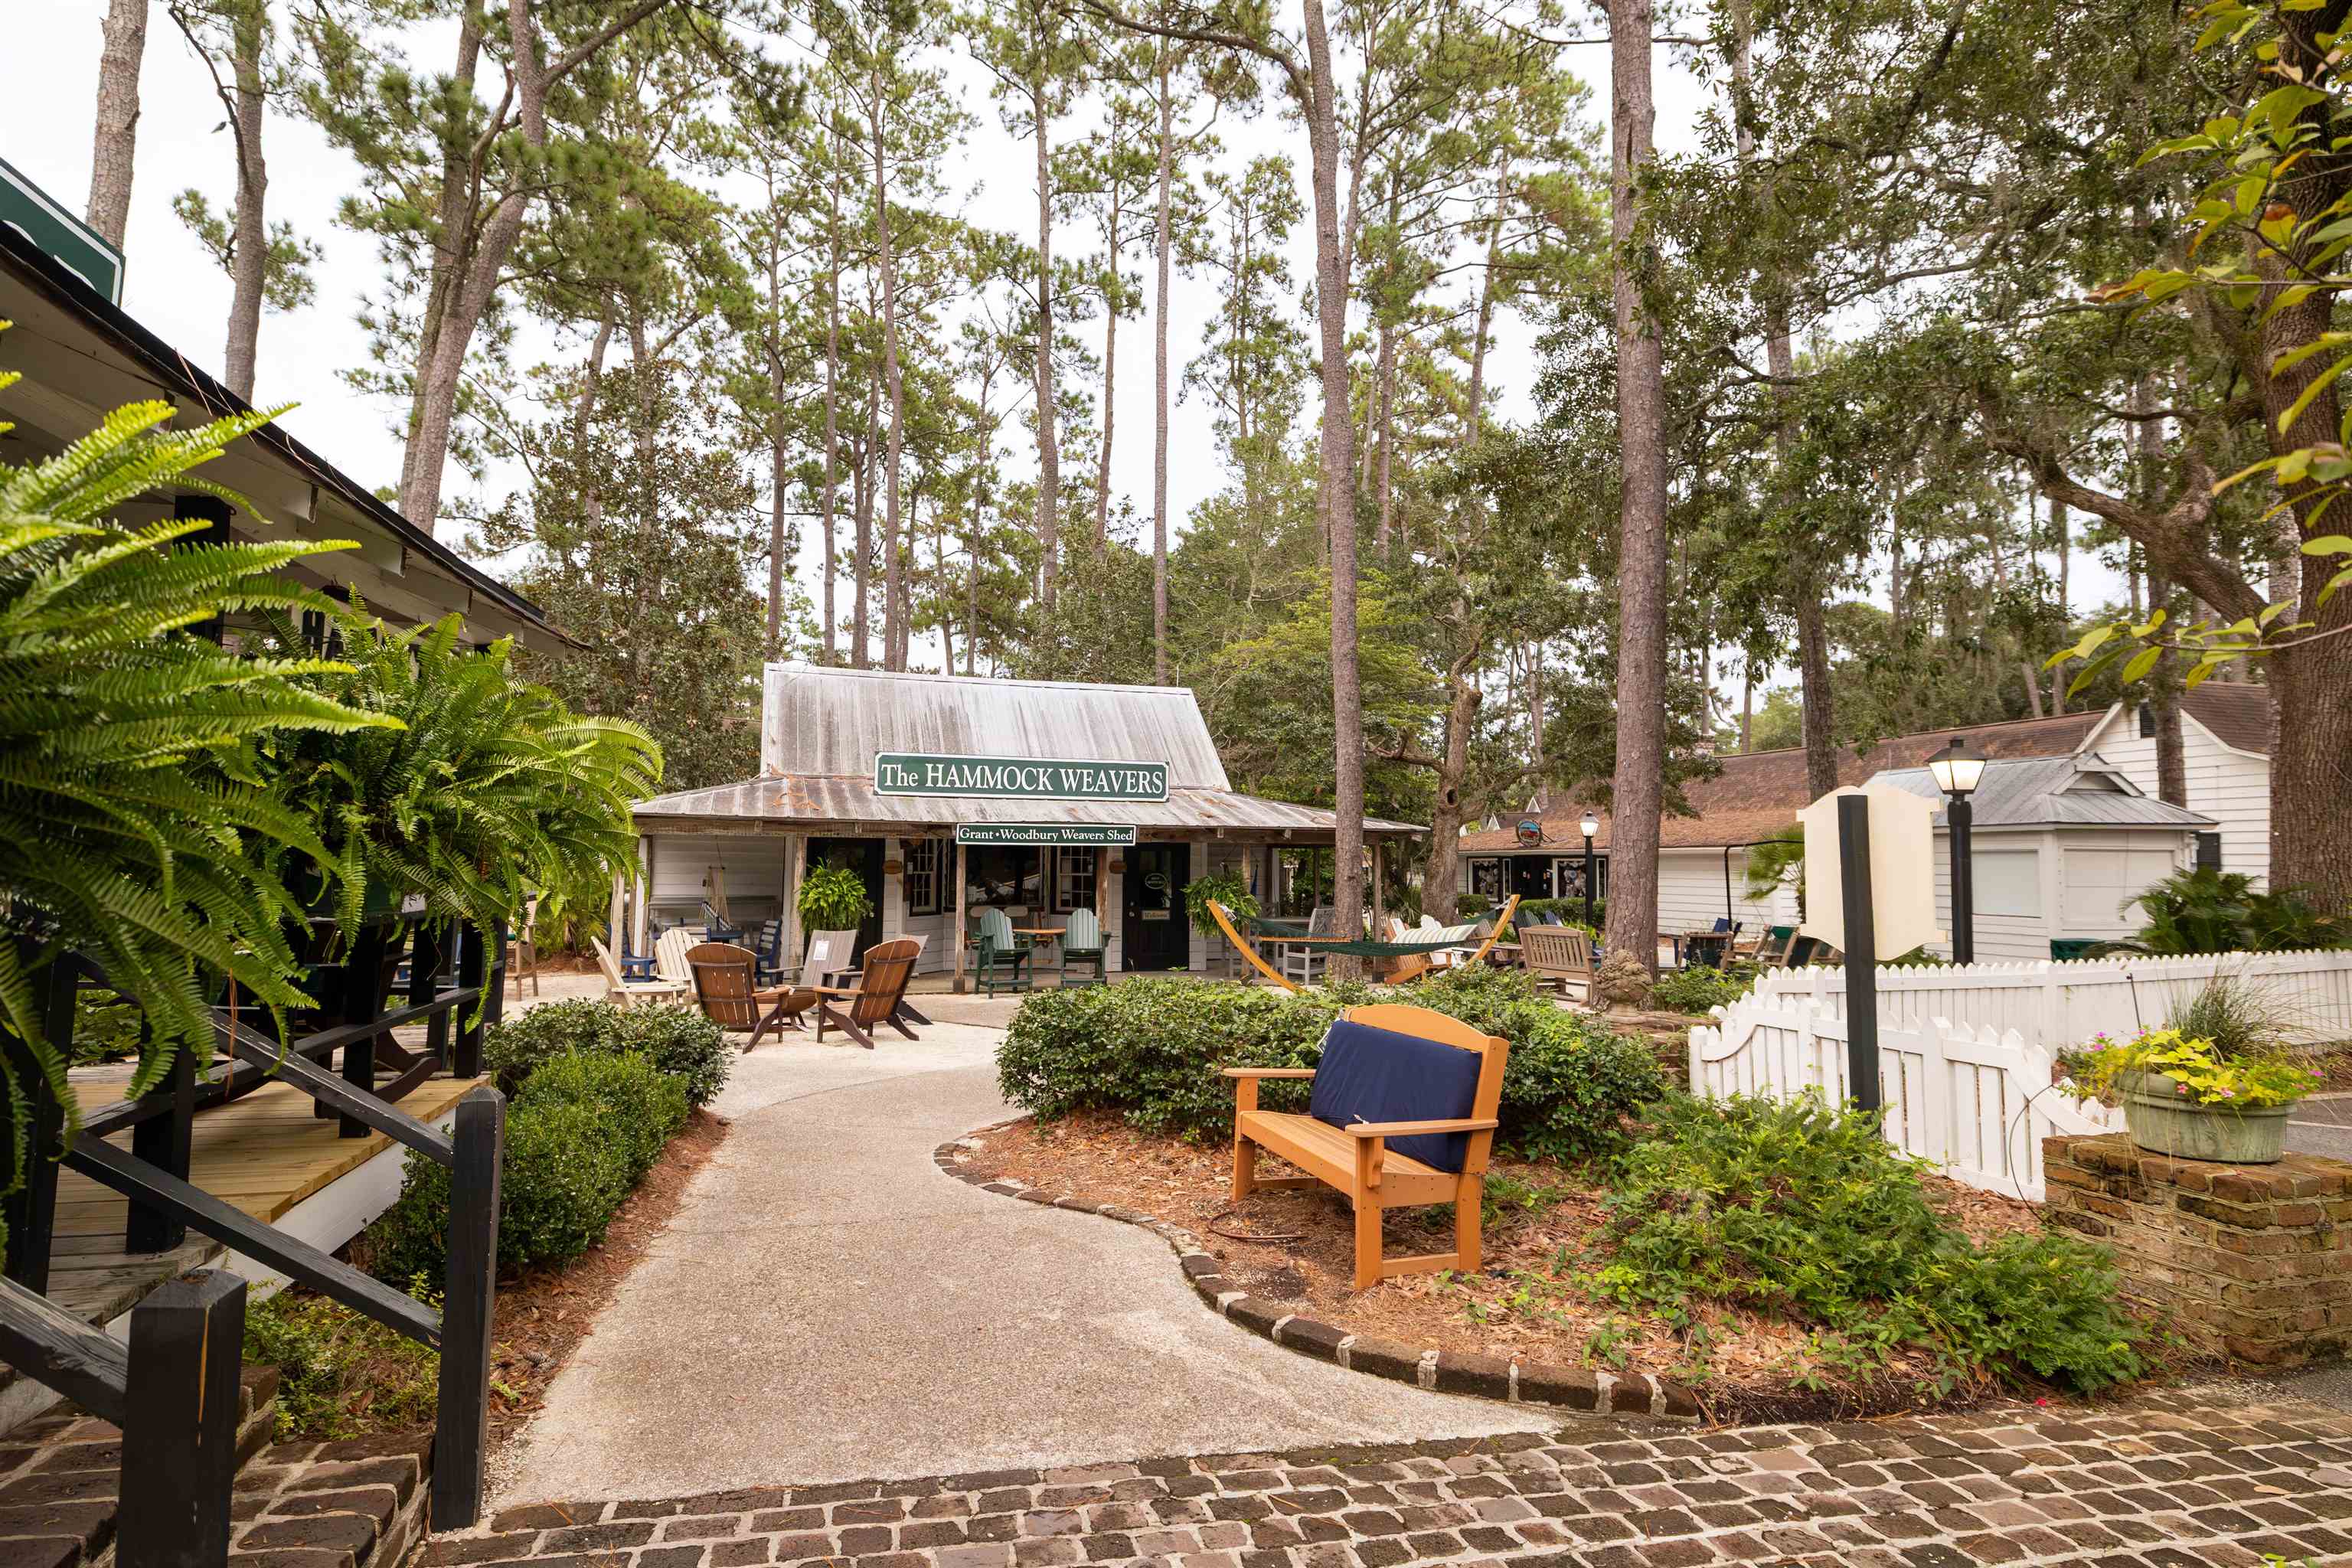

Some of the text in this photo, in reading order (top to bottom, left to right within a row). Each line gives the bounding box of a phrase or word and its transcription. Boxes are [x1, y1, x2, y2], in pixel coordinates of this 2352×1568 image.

[881, 764, 1163, 794] The HAMMOCK WEAVERS
[1061, 829, 1104, 840] Weavers
[1107, 830, 1133, 841] Shed
